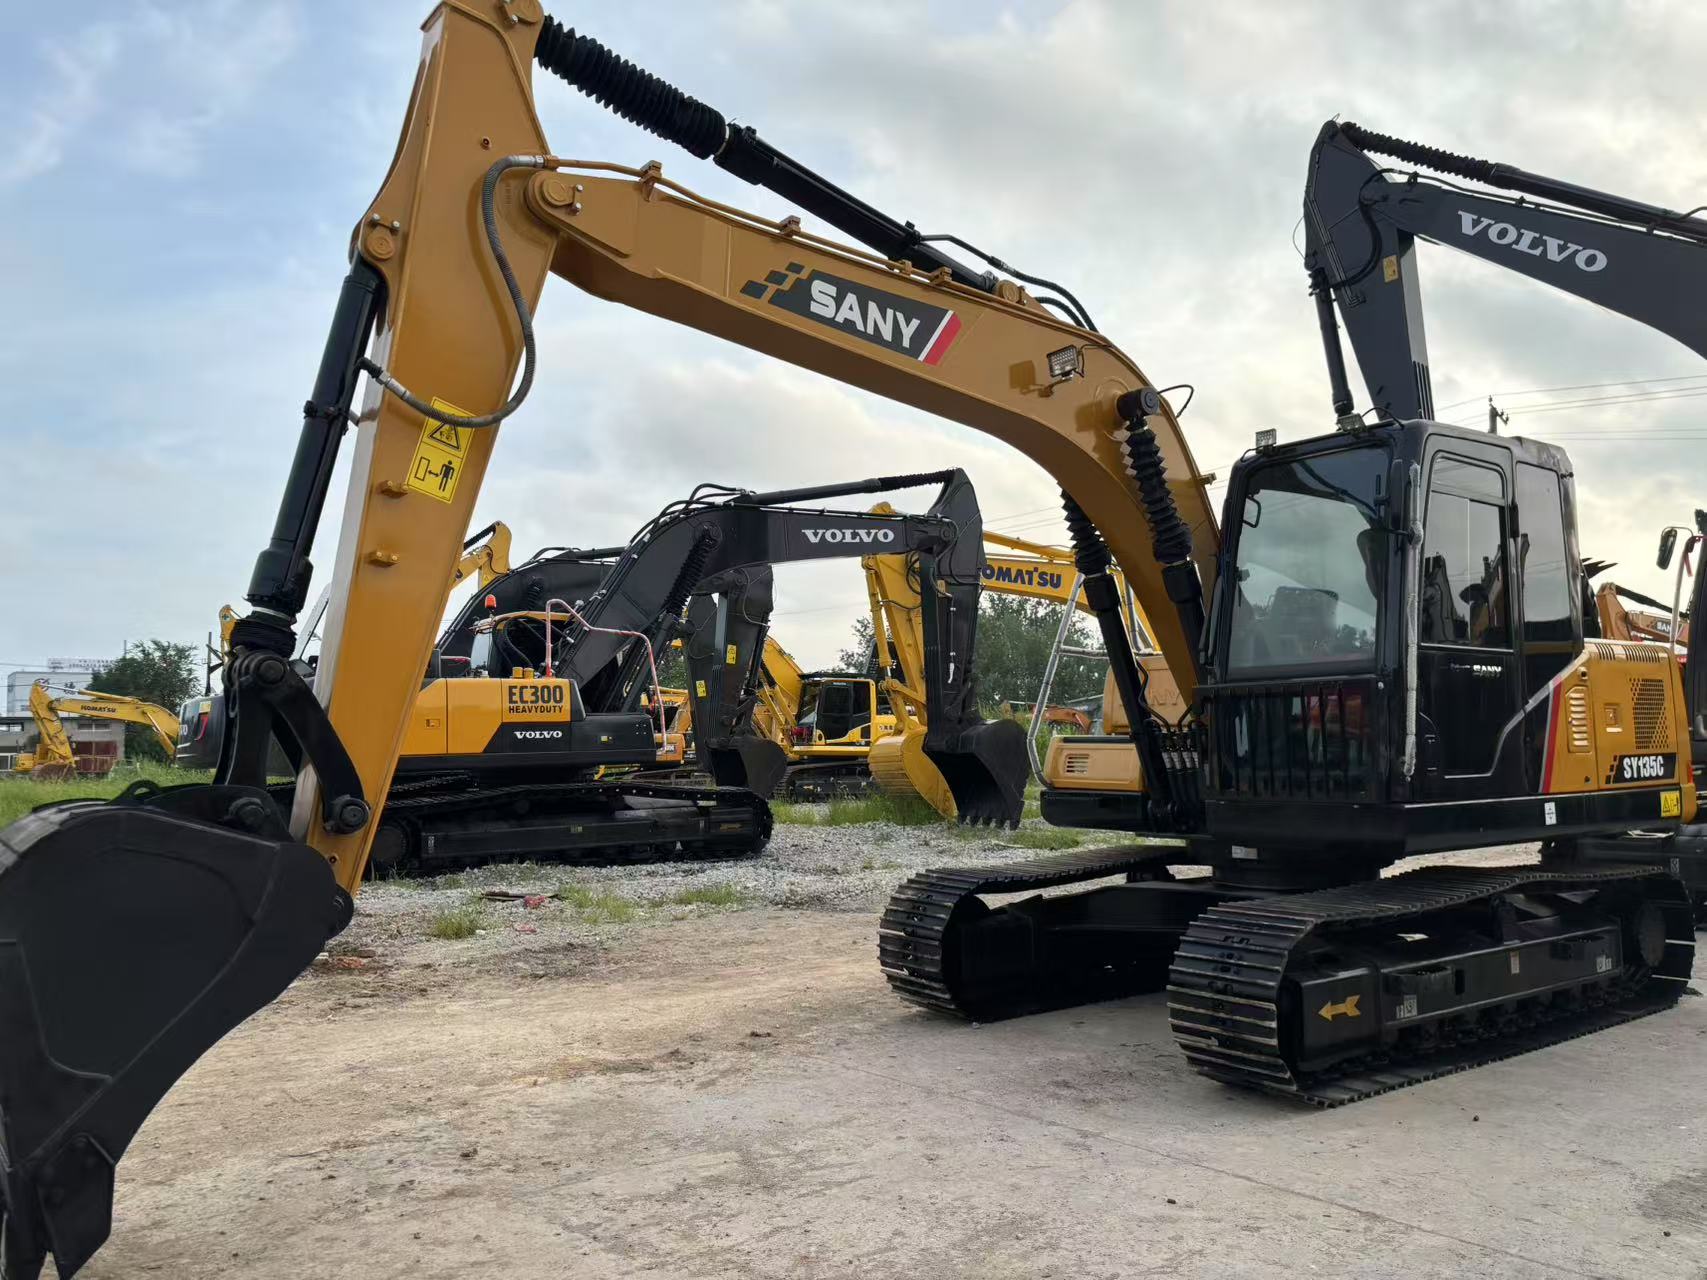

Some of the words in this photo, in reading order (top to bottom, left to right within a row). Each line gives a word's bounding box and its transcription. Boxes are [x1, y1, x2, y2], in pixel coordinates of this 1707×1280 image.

[1457, 210, 1608, 273] VOLVO
[809, 279, 921, 349] SANY
[801, 528, 895, 543] VOLVO
[980, 564, 1063, 589] OMATSU
[508, 685, 563, 705] EC300
[80, 704, 116, 713] KOMATSU
[508, 705, 563, 714] HEAVYDUTY
[513, 730, 563, 739] VOLVO
[1622, 755, 1664, 779] SY135C
